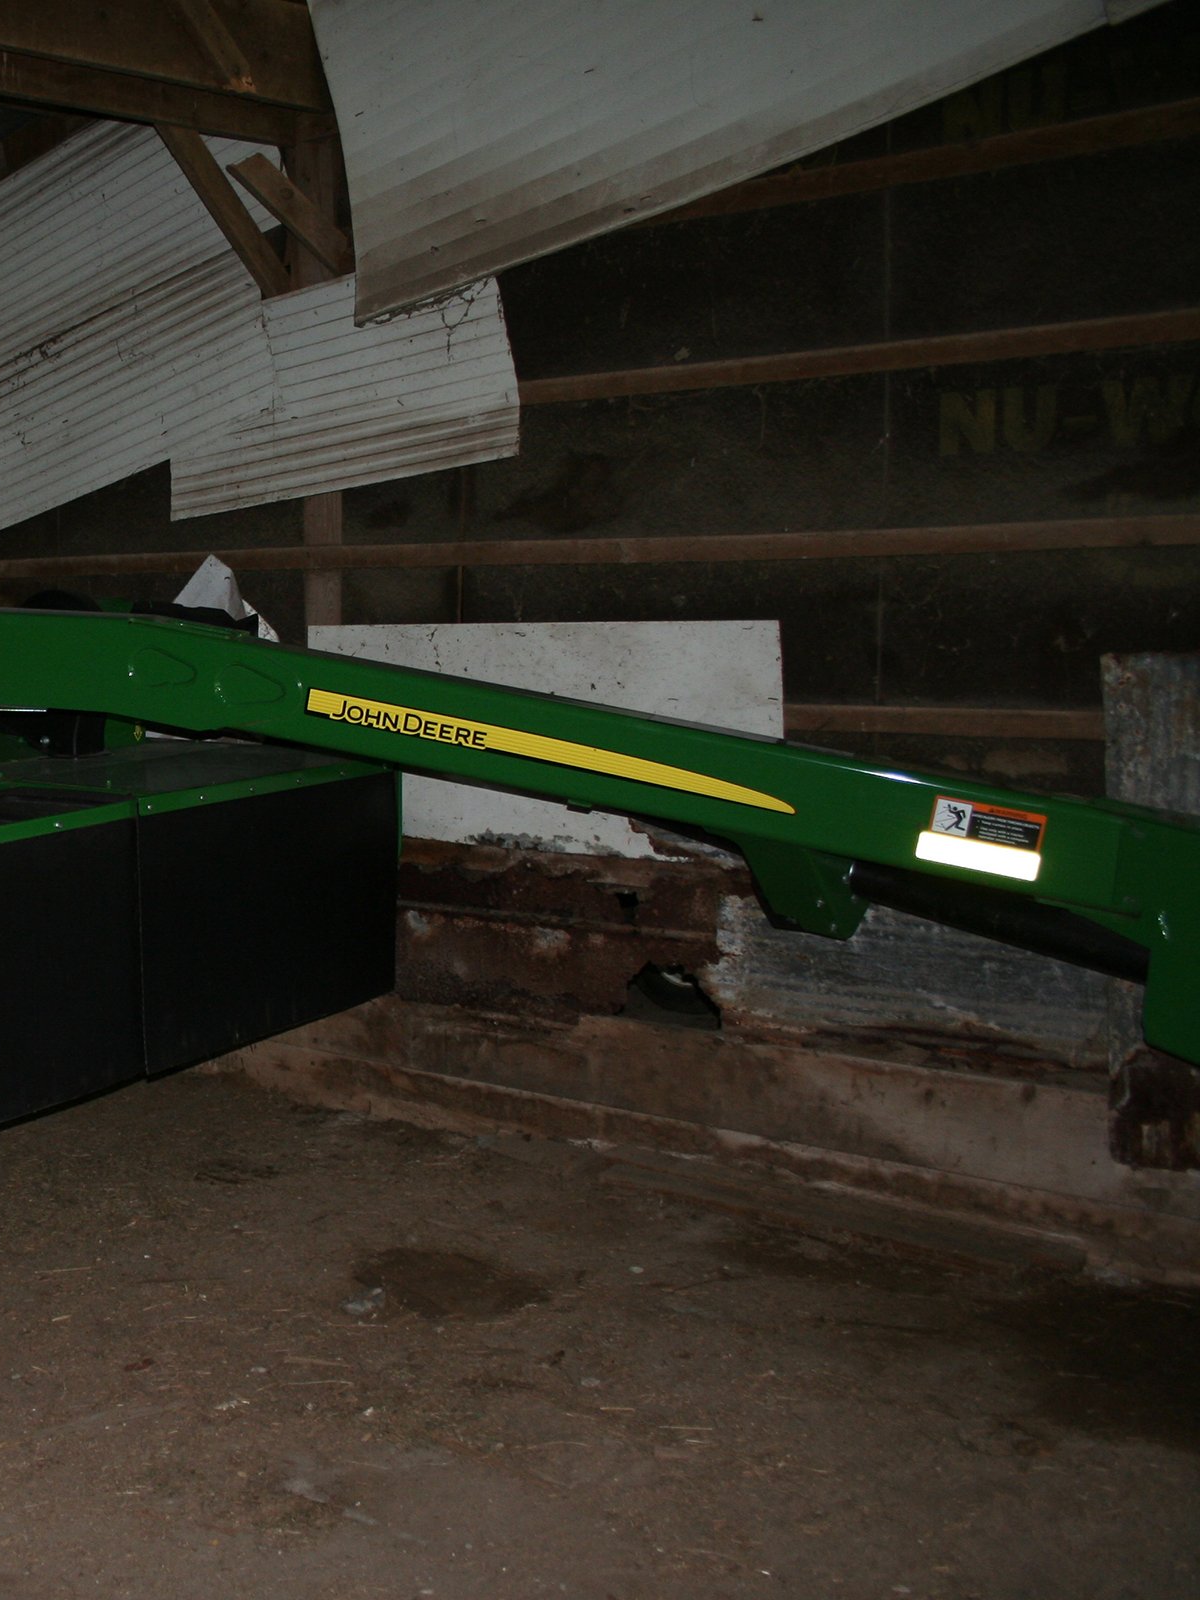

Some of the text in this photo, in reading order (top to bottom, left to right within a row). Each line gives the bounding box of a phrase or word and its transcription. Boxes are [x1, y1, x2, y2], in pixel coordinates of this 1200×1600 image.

[939, 374, 1200, 456] NU-W
[331, 700, 488, 748] JOHN DEERE
